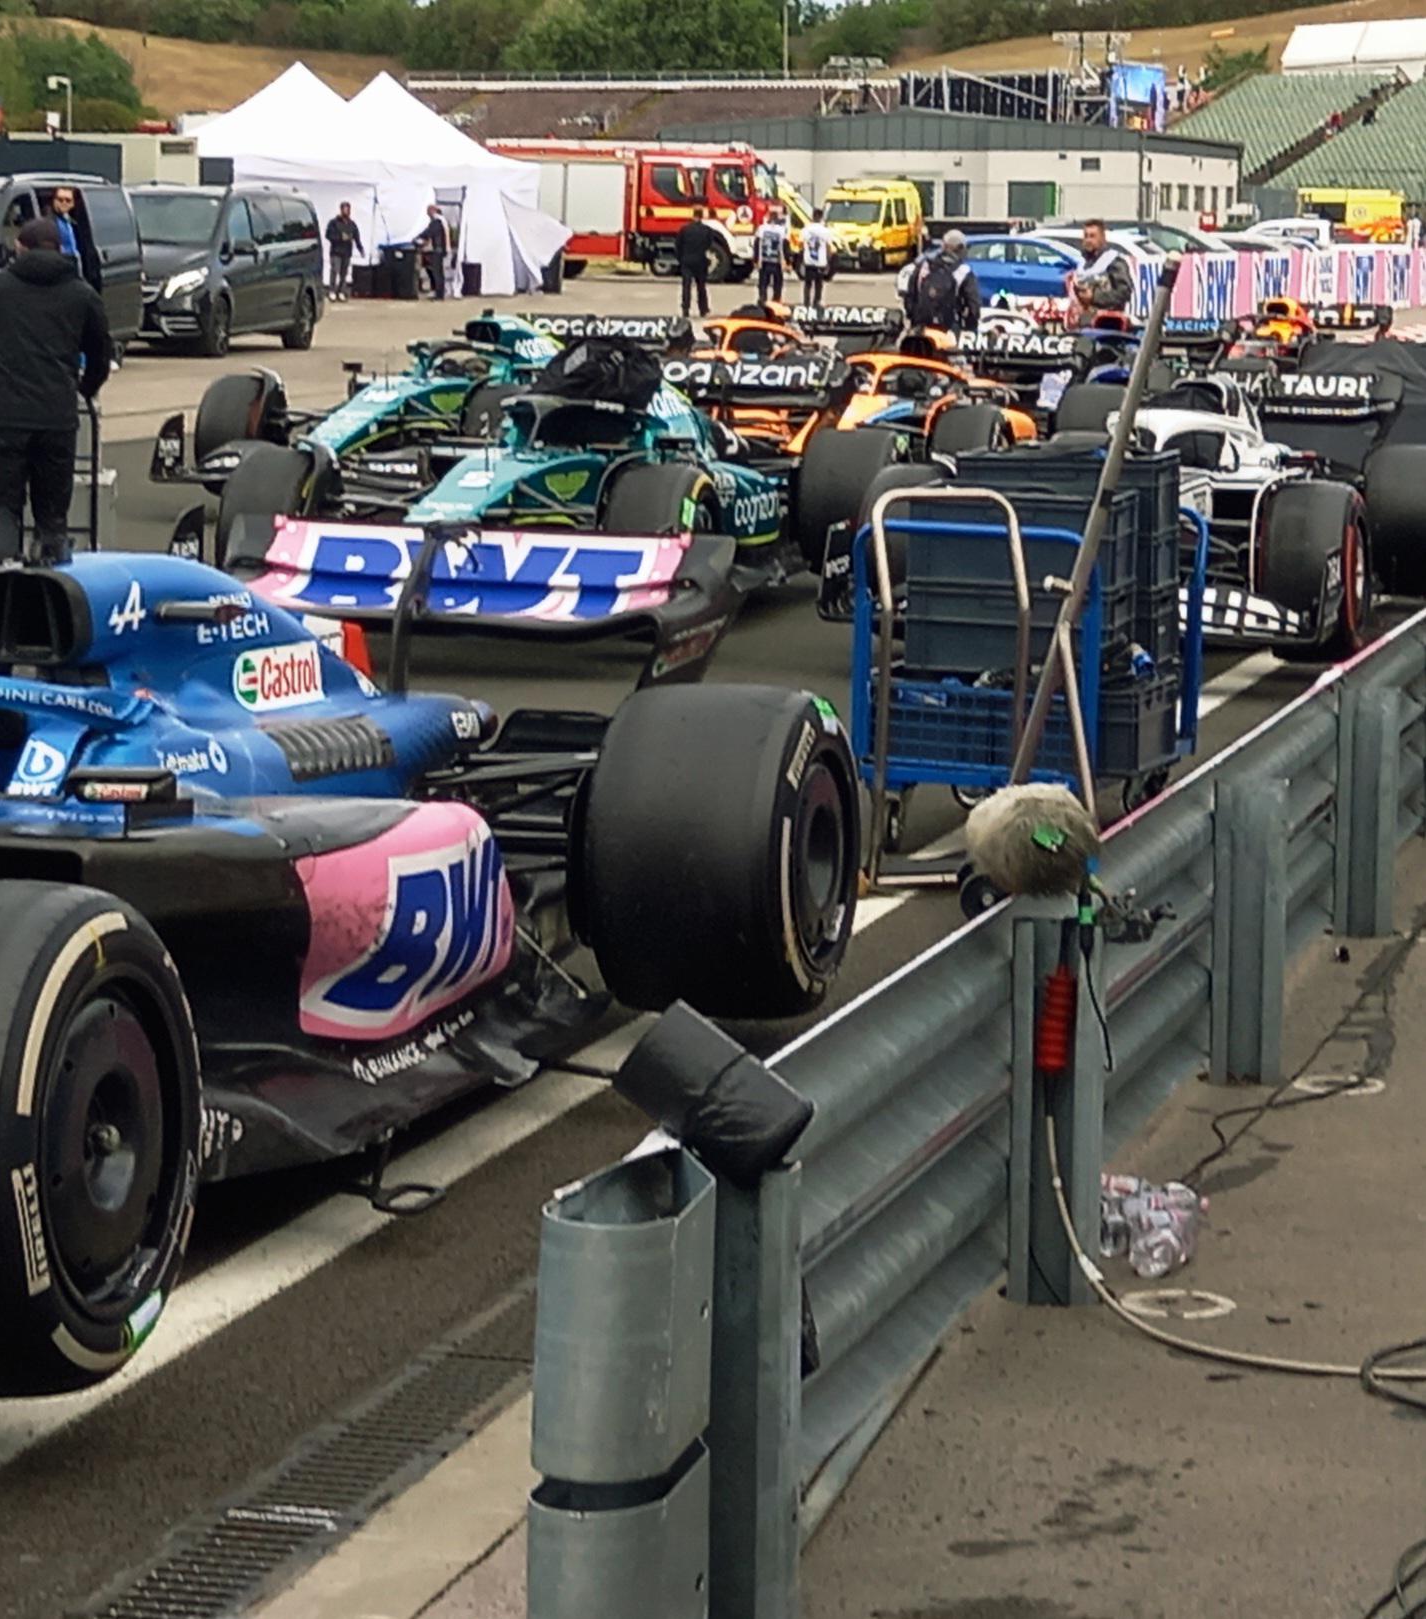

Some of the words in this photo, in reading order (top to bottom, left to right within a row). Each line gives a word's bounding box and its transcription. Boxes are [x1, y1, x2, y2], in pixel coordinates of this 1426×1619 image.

[1206, 260, 1235, 320] BWT
[662, 360, 820, 386] ogizant
[294, 534, 644, 620] BWT
[260, 650, 320, 701] Castrol
[11, 1162, 52, 1296] PIRELLI
